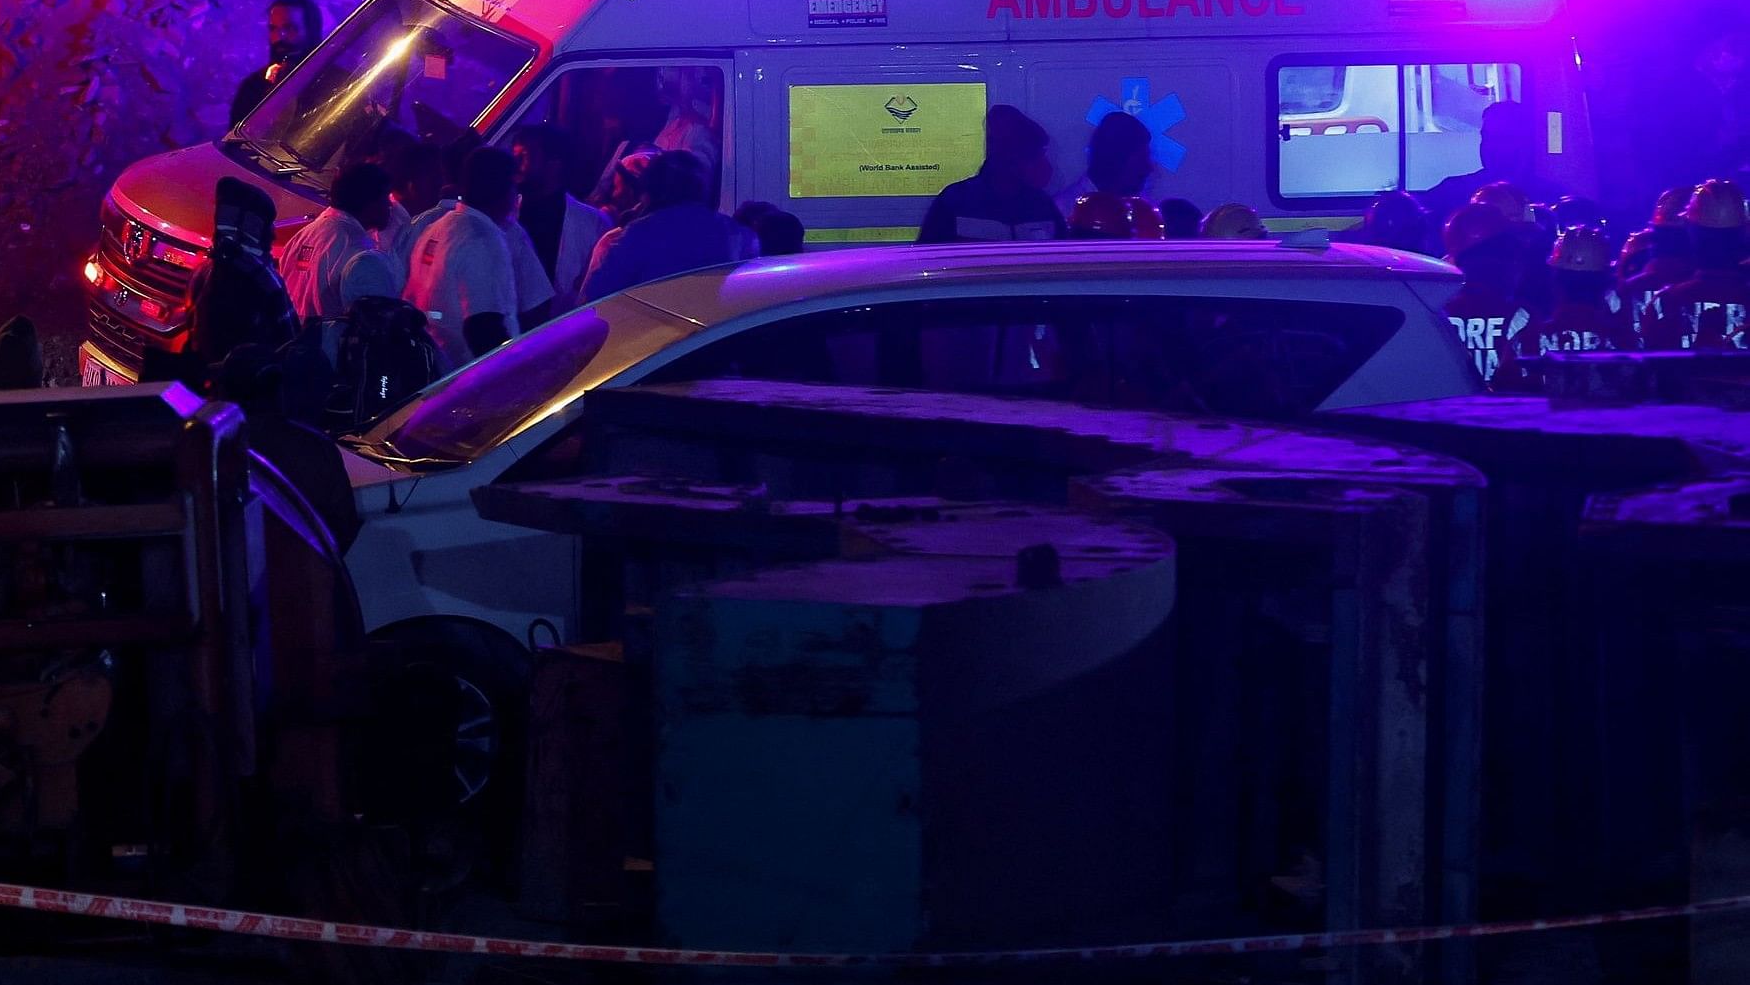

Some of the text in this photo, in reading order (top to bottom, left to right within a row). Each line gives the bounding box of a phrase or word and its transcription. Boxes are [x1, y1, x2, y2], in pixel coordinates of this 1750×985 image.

[859, 163, 941, 173] (World Bank Assisted)
